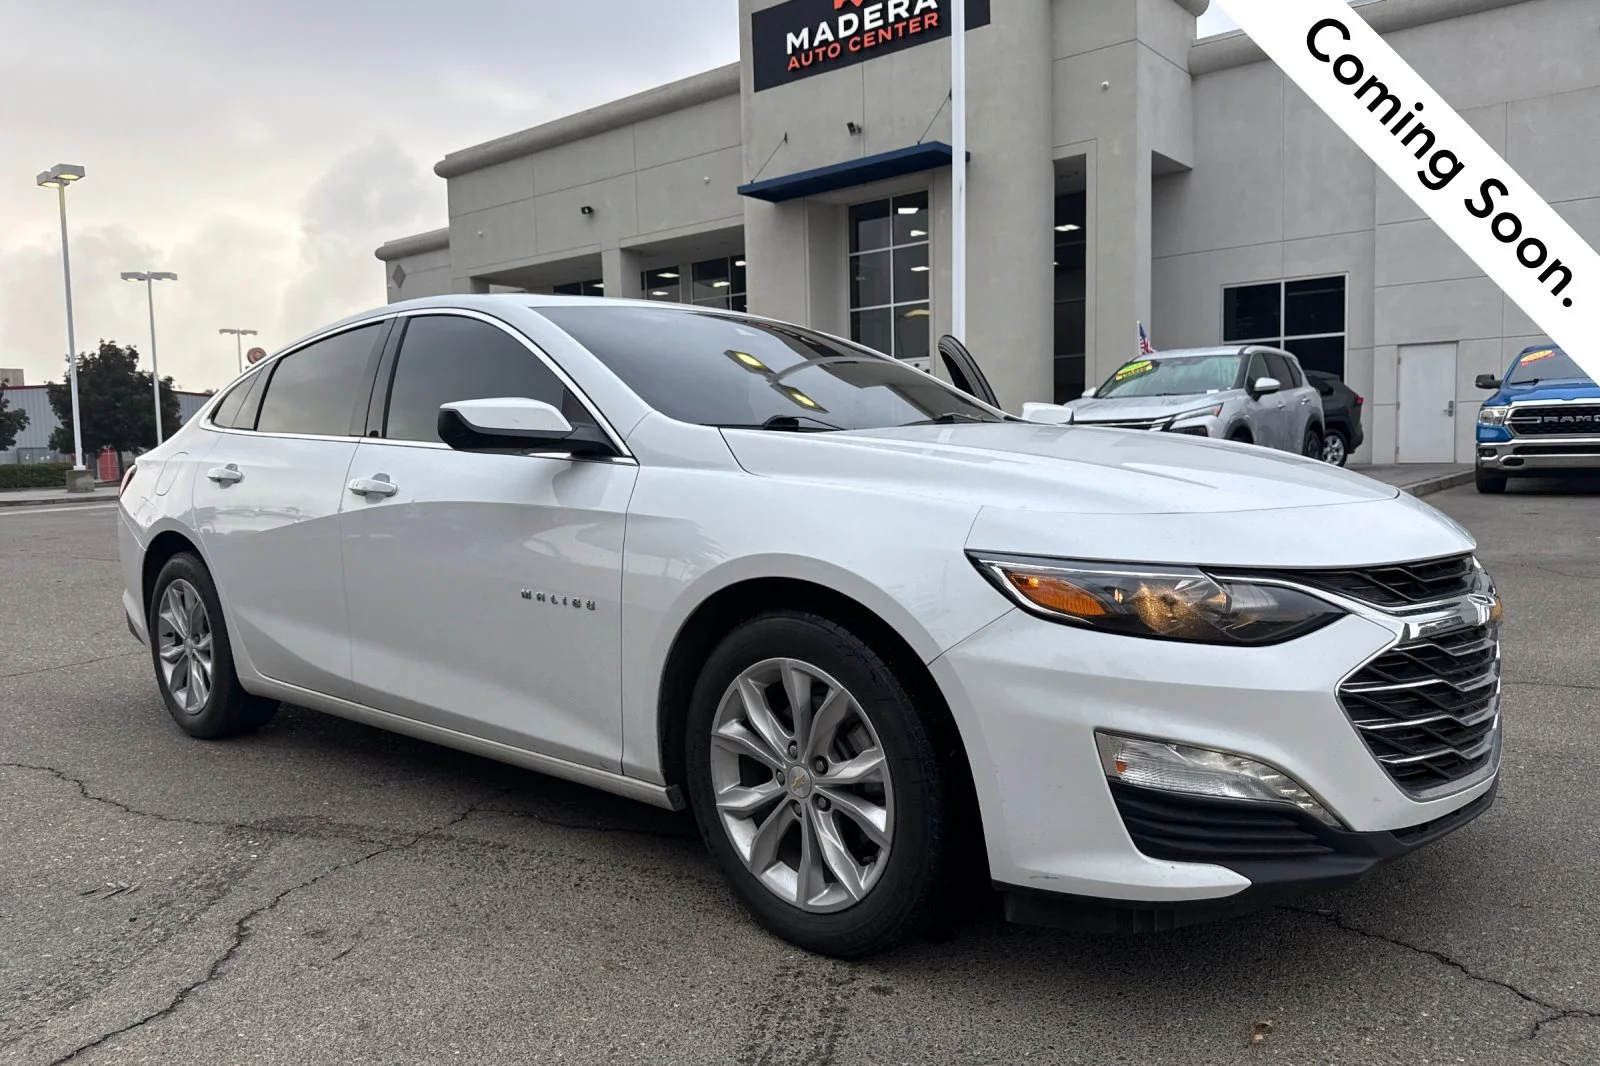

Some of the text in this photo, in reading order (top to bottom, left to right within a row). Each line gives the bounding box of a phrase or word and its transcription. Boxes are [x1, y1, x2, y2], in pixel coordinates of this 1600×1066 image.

[786, 0, 938, 55] MADERA
[787, 12, 938, 71] AUTO CENTER
[1544, 415, 1592, 423] RAM
[521, 588, 596, 611] MALIBU
